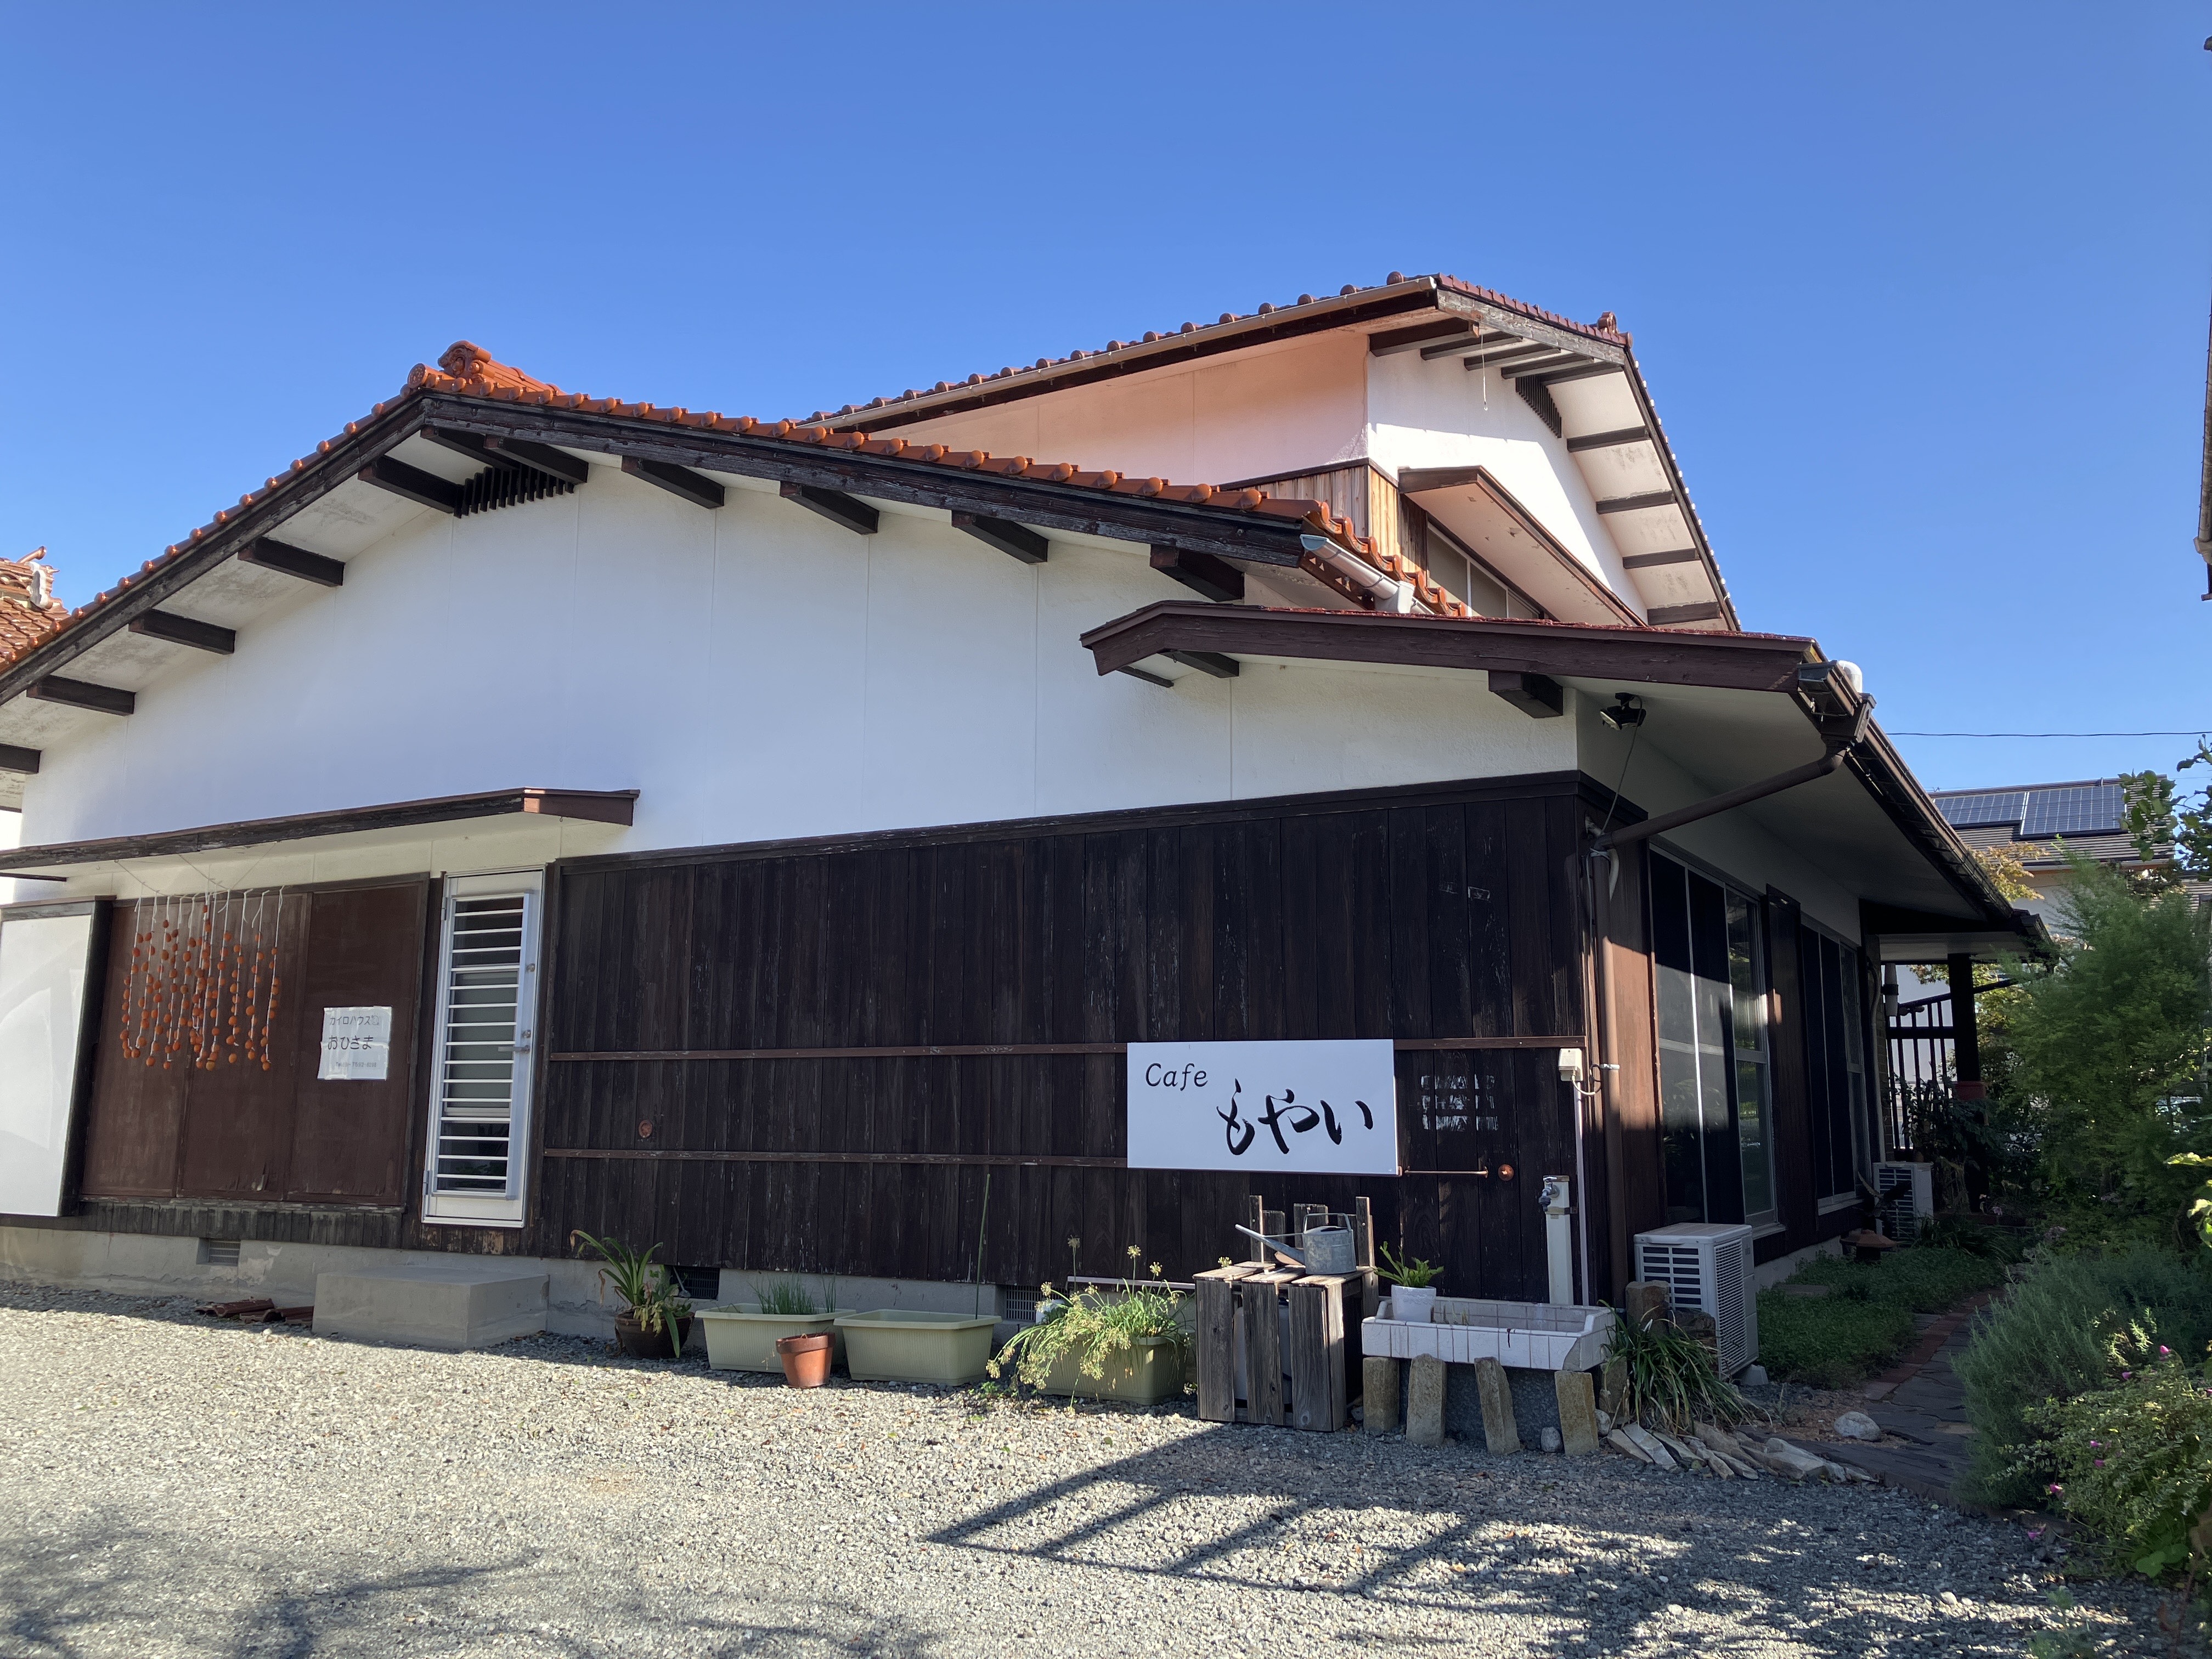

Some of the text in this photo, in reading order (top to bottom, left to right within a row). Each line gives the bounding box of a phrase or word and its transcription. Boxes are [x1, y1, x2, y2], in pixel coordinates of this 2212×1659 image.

[330, 1016, 370, 1025] カイロハウス
[328, 1035, 374, 1050] おひさま
[1145, 1062, 1208, 1091] Cafe
[1216, 1077, 1373, 1156] もやい
